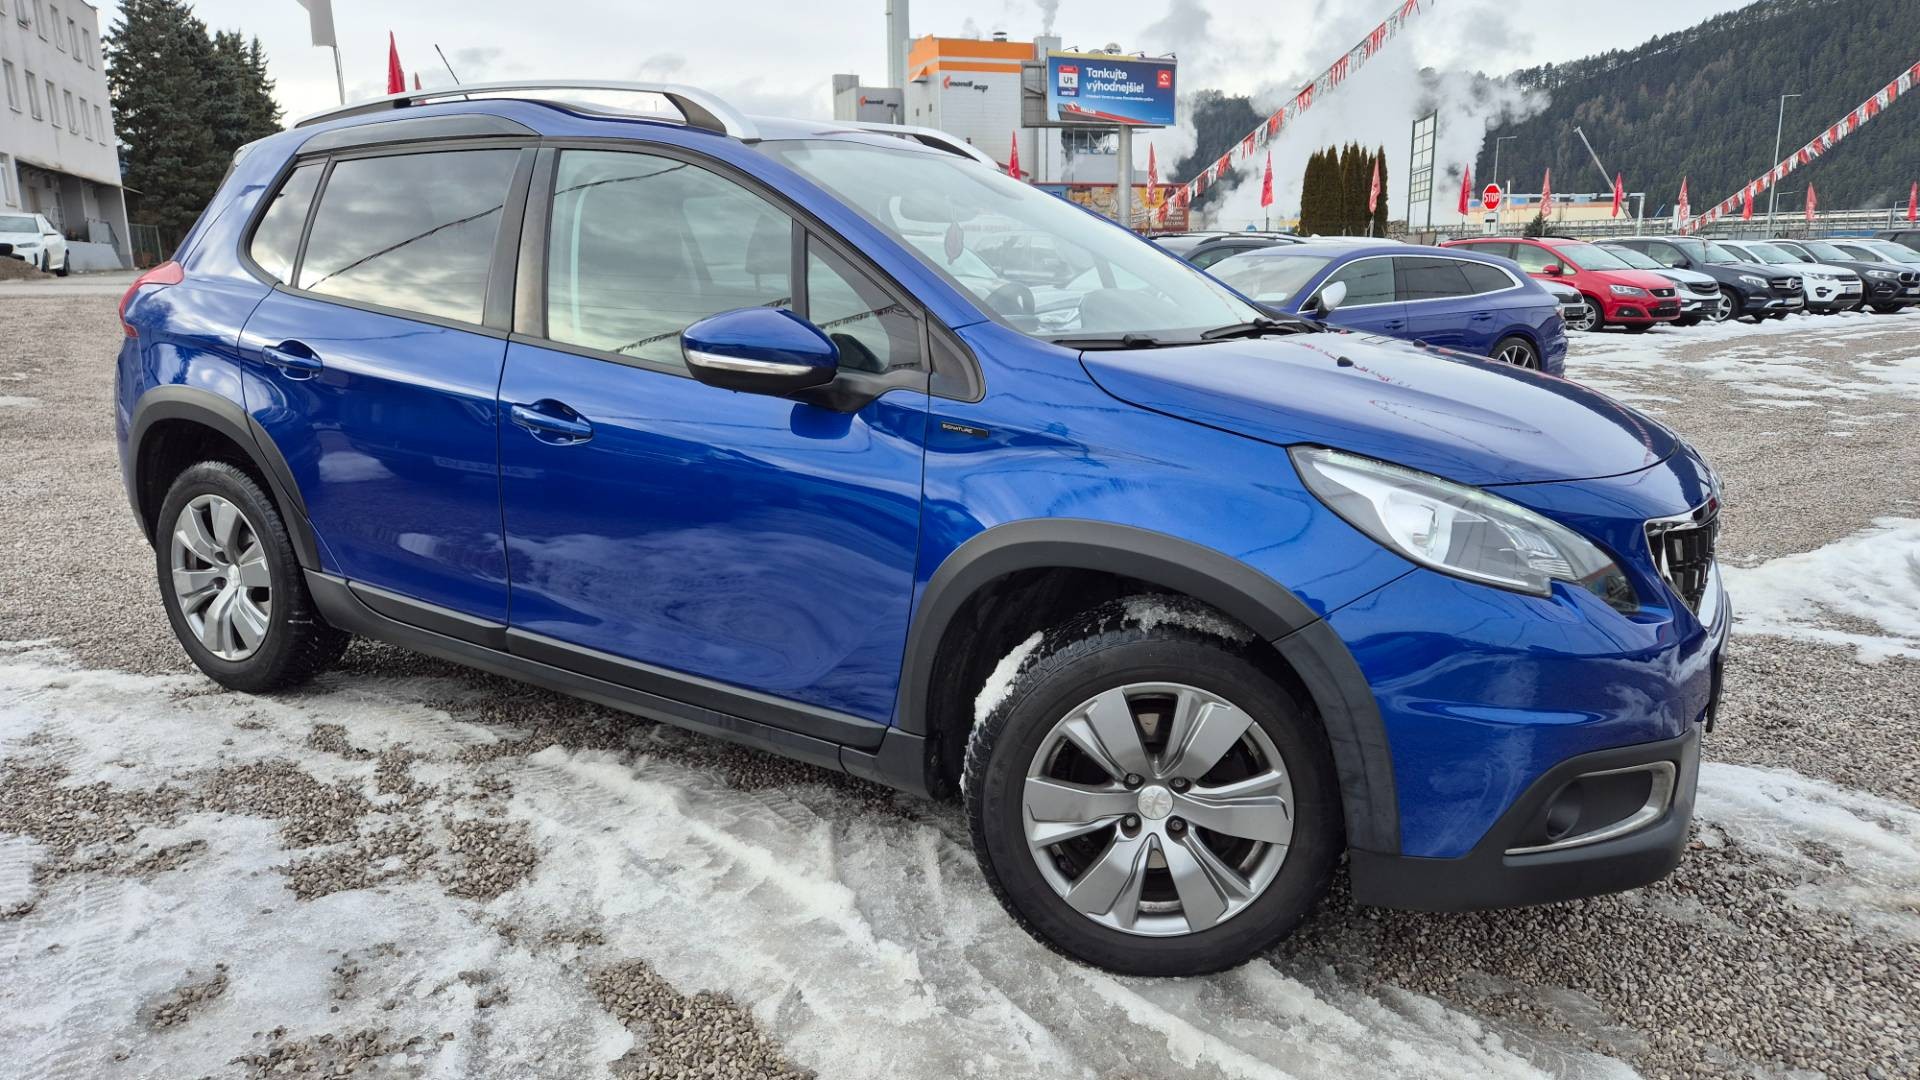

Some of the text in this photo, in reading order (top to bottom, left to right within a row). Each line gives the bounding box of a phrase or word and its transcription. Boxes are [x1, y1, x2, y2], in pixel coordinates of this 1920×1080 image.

[1086, 67, 1127, 80] Tankujte
[1063, 76, 1073, 84] Ut
[1086, 81, 1144, 94] výhodnejšie!
[1485, 193, 1500, 203] STOP
[942, 424, 973, 434] SIGNATURE
